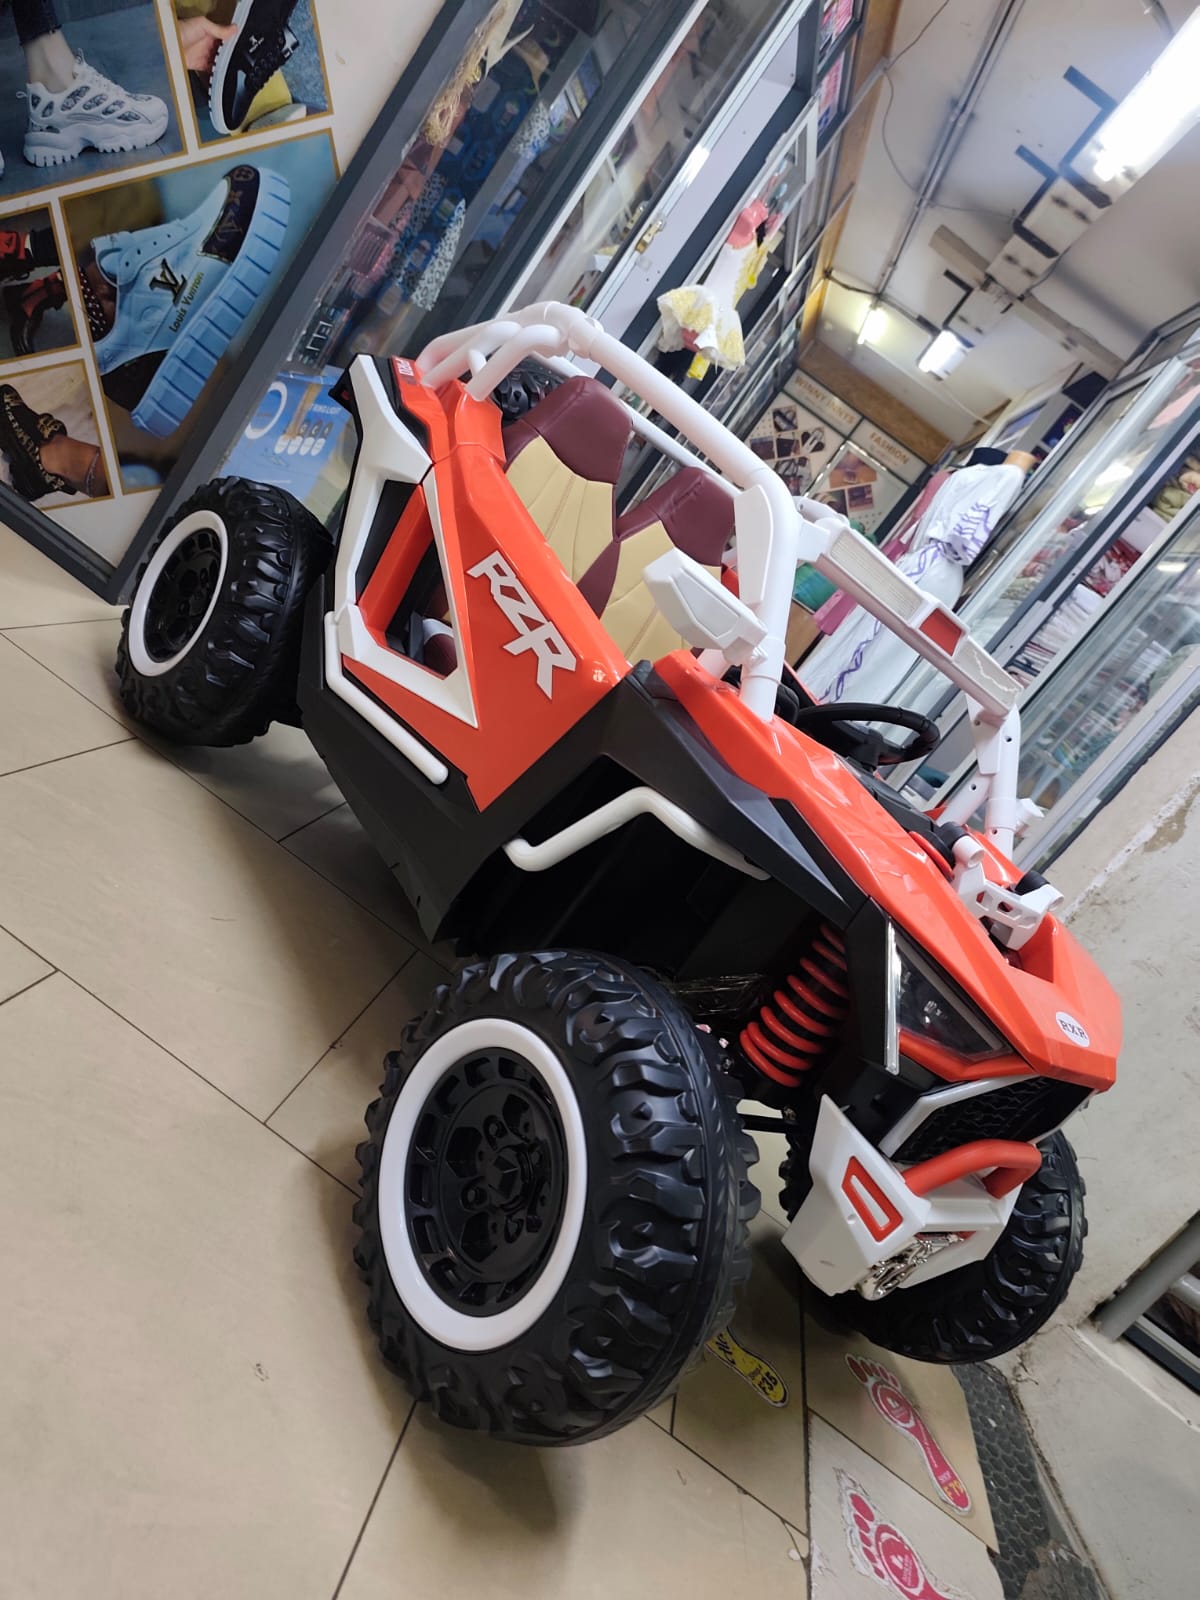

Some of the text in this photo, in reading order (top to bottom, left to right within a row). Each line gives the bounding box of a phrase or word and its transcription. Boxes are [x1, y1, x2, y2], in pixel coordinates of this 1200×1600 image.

[168, 308, 187, 333] Louis
[869, 432, 910, 464] FASHION
[467, 551, 576, 700] RZR
[1059, 1019, 1087, 1040] RXR
